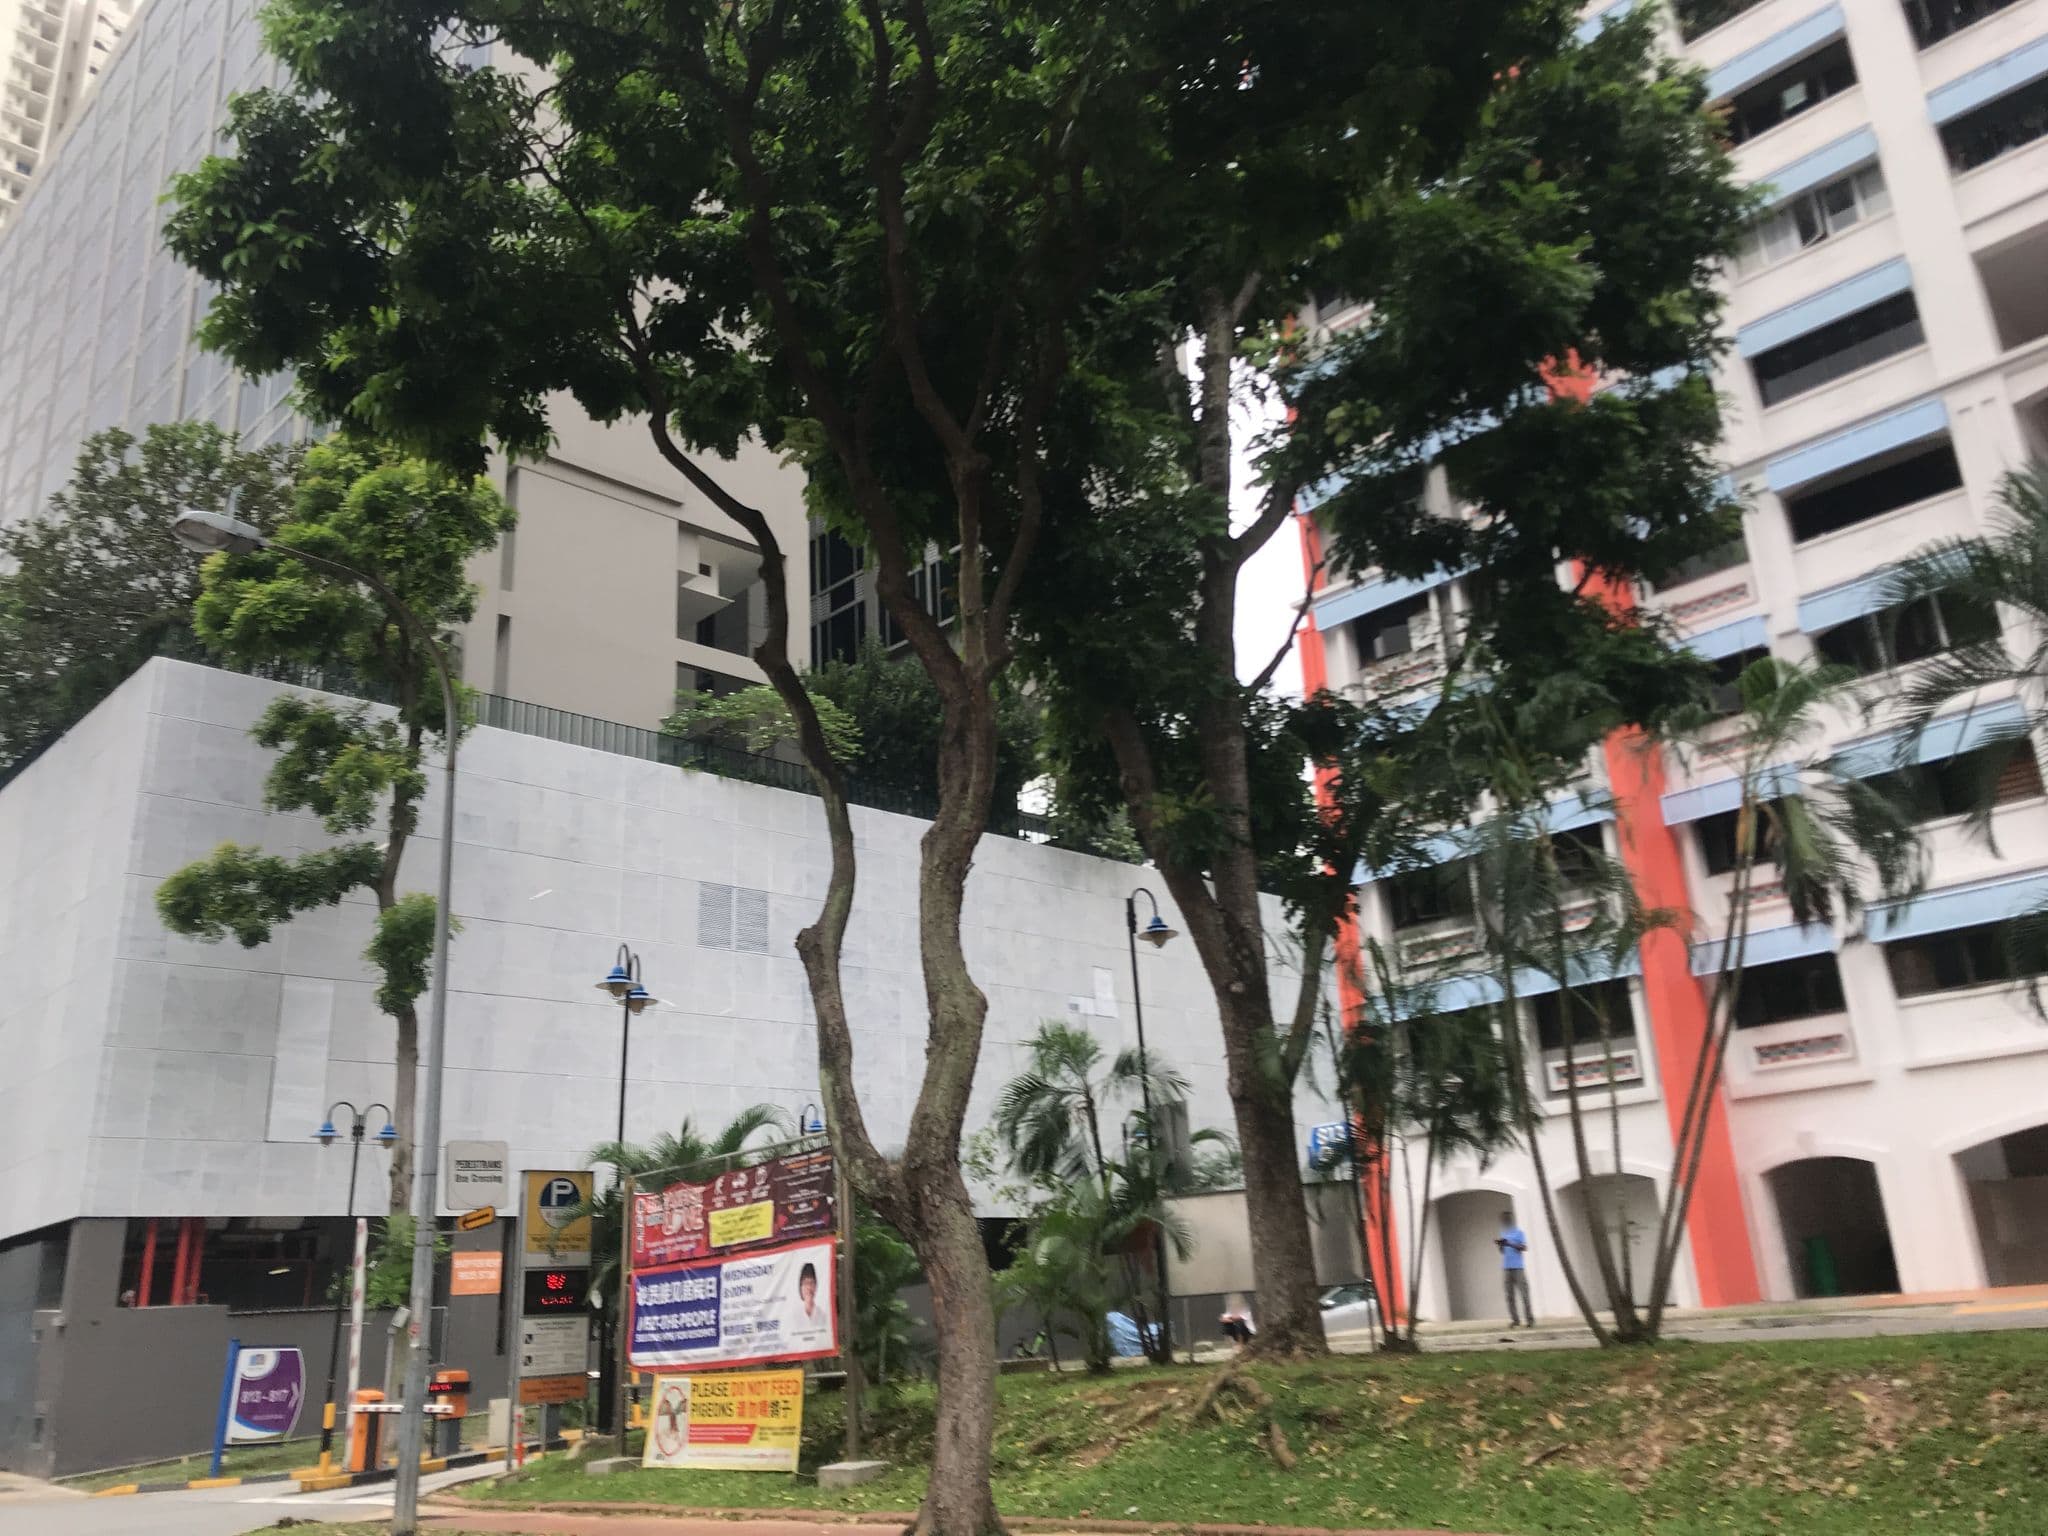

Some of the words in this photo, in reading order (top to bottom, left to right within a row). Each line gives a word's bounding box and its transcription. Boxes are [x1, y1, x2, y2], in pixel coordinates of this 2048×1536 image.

[456, 1174, 469, 1183] Use
[471, 1174, 502, 1184] Crossing
[551, 1181, 574, 1206] P
[691, 1381, 729, 1398] PLEASE
[691, 1402, 734, 1418] PIGEONS
